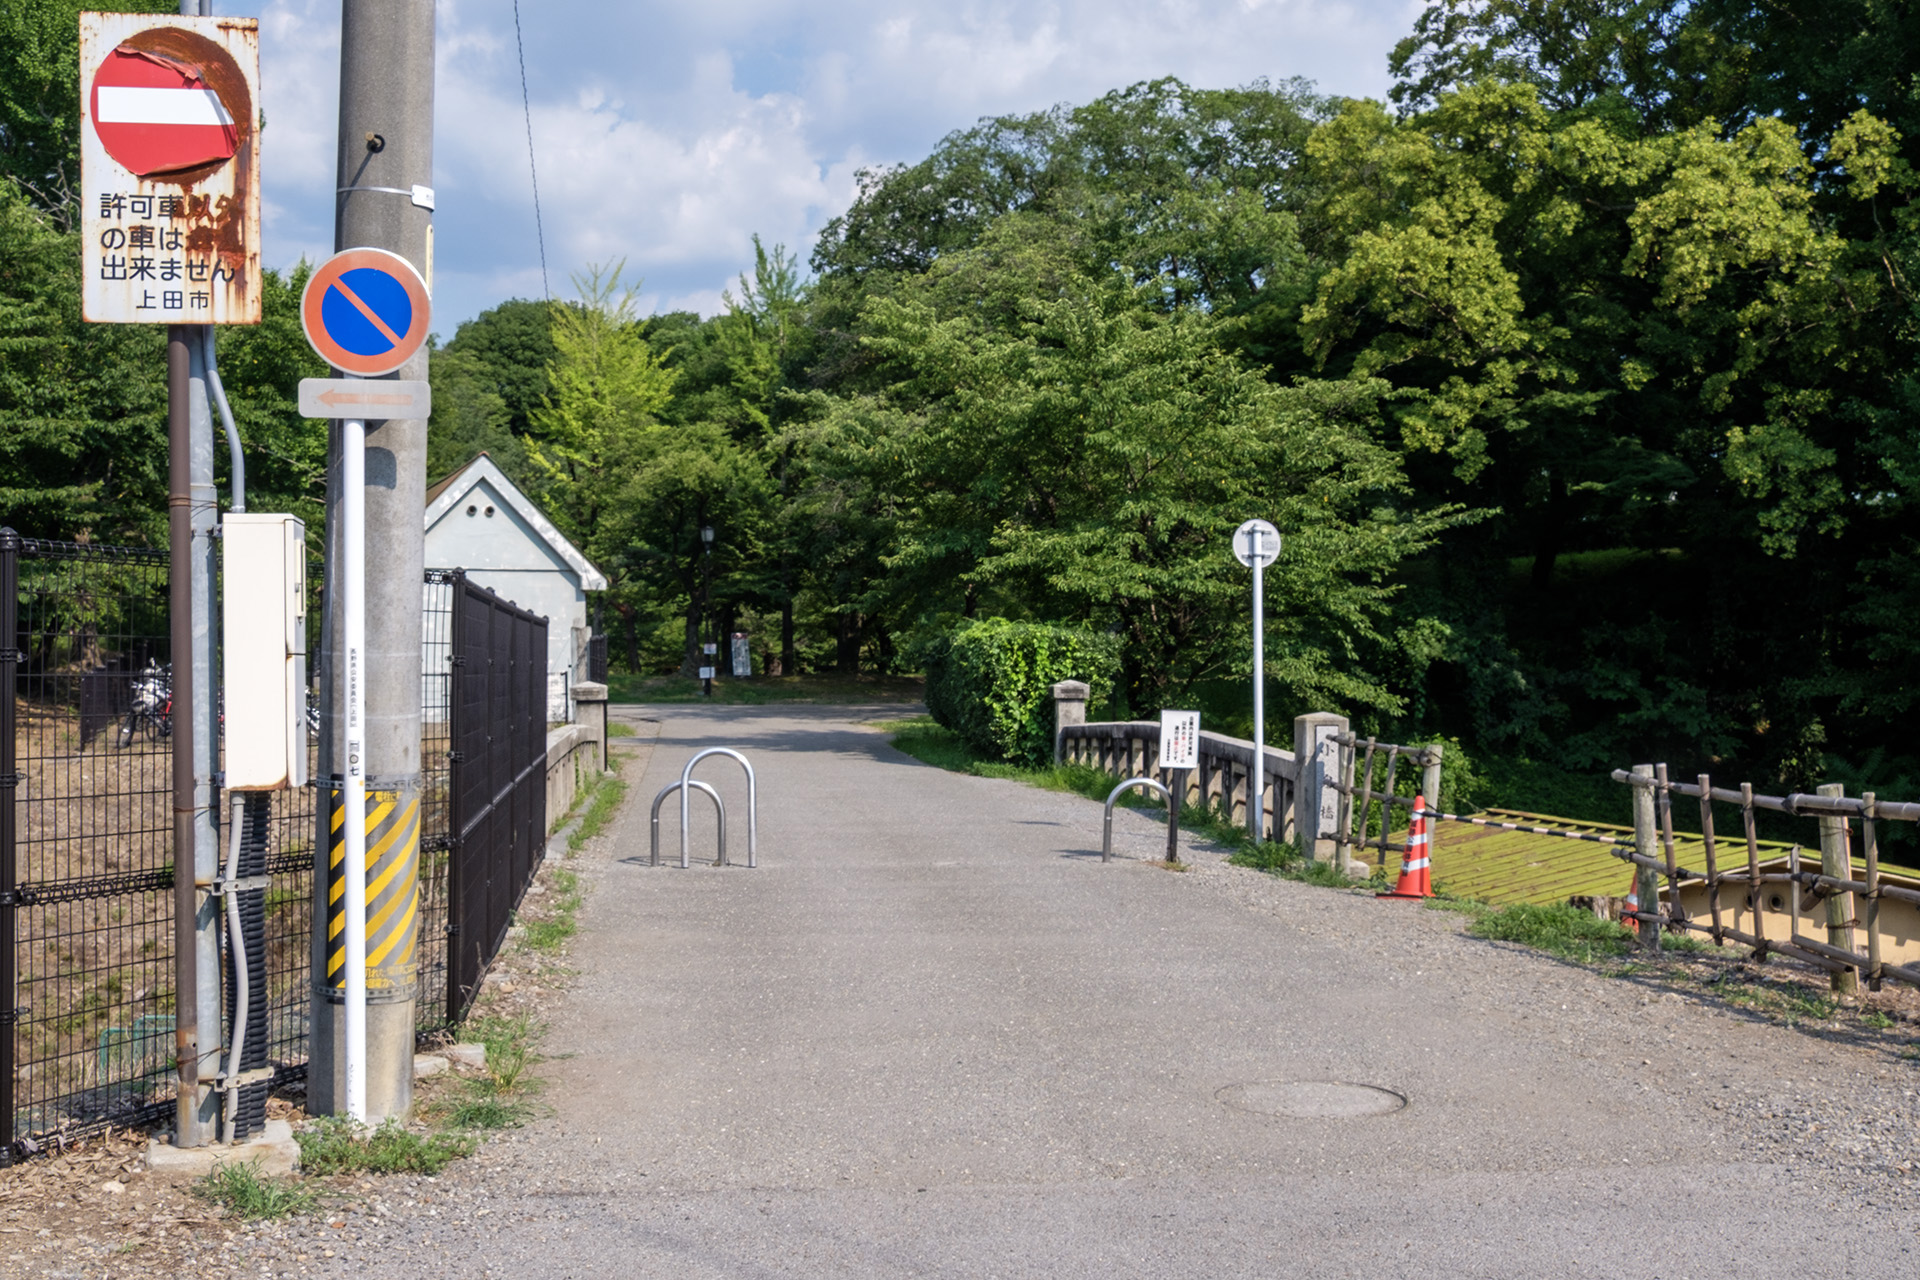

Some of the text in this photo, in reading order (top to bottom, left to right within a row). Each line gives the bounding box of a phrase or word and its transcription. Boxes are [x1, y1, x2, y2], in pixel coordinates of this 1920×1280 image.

[101, 225, 245, 251] の車は
[101, 254, 236, 283] 出来ません
[136, 290, 210, 309] 上田市
